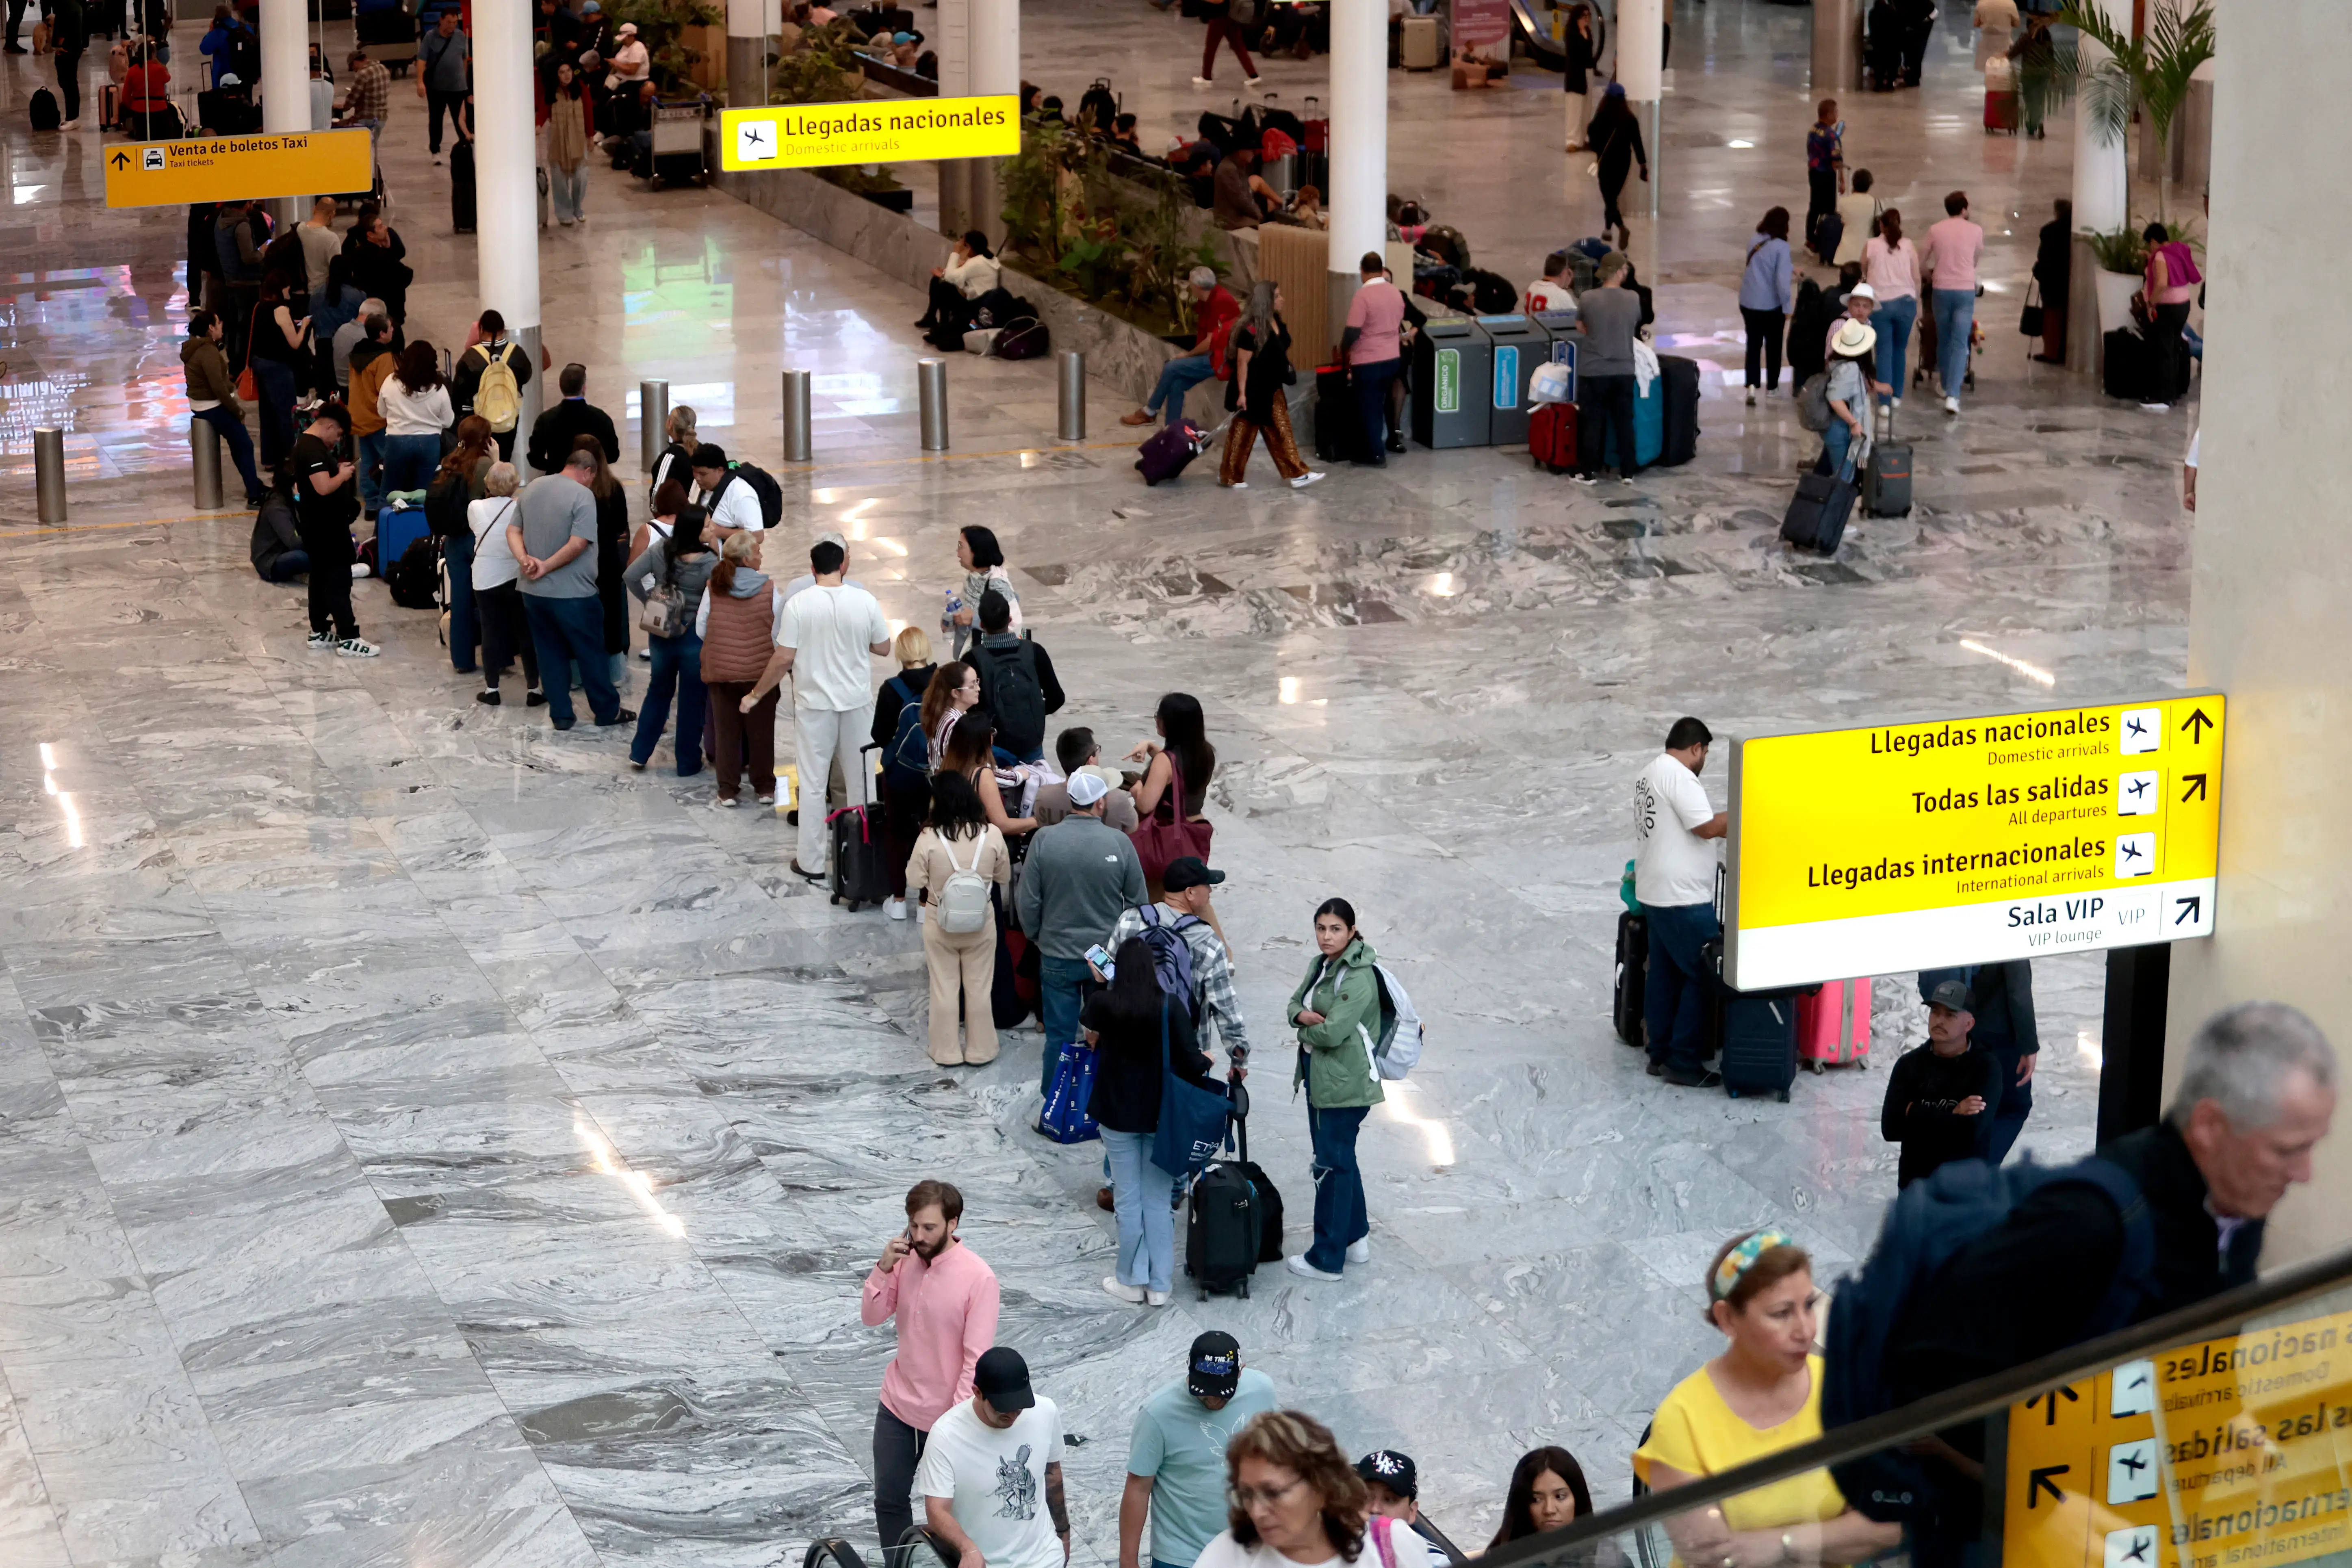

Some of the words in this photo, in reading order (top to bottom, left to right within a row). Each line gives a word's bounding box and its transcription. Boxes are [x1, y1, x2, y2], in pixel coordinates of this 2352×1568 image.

[786, 113, 882, 139] Llegadas
[890, 106, 1006, 130] nacionales
[169, 144, 206, 156] Venta
[211, 141, 226, 153] de
[230, 139, 278, 152] boletos
[282, 136, 308, 149] Taxi
[786, 141, 847, 155] Domestic
[851, 138, 900, 152] arrivals
[187, 158, 214, 167] tickets
[1871, 725, 1977, 757] Llegadas
[1985, 711, 2110, 744] nacionales
[1988, 747, 2053, 766] Domestic
[2057, 741, 2109, 759] arrivals
[1912, 787, 1979, 813] Todas
[1986, 783, 2020, 806] las
[2027, 774, 2109, 802] salidas
[2008, 811, 2027, 826] All
[2032, 805, 2107, 825] departures
[1808, 857, 1915, 890] Llegadas
[1923, 836, 2105, 875] internacionales
[1957, 872, 2048, 894] International
[2053, 865, 2104, 884] arrivals
[2007, 902, 2057, 928] Sala
[2066, 897, 2103, 920] VIP
[2118, 908, 2146, 926] VIP
[2028, 931, 2051, 947] VIP
[2055, 927, 2102, 946] lounge
